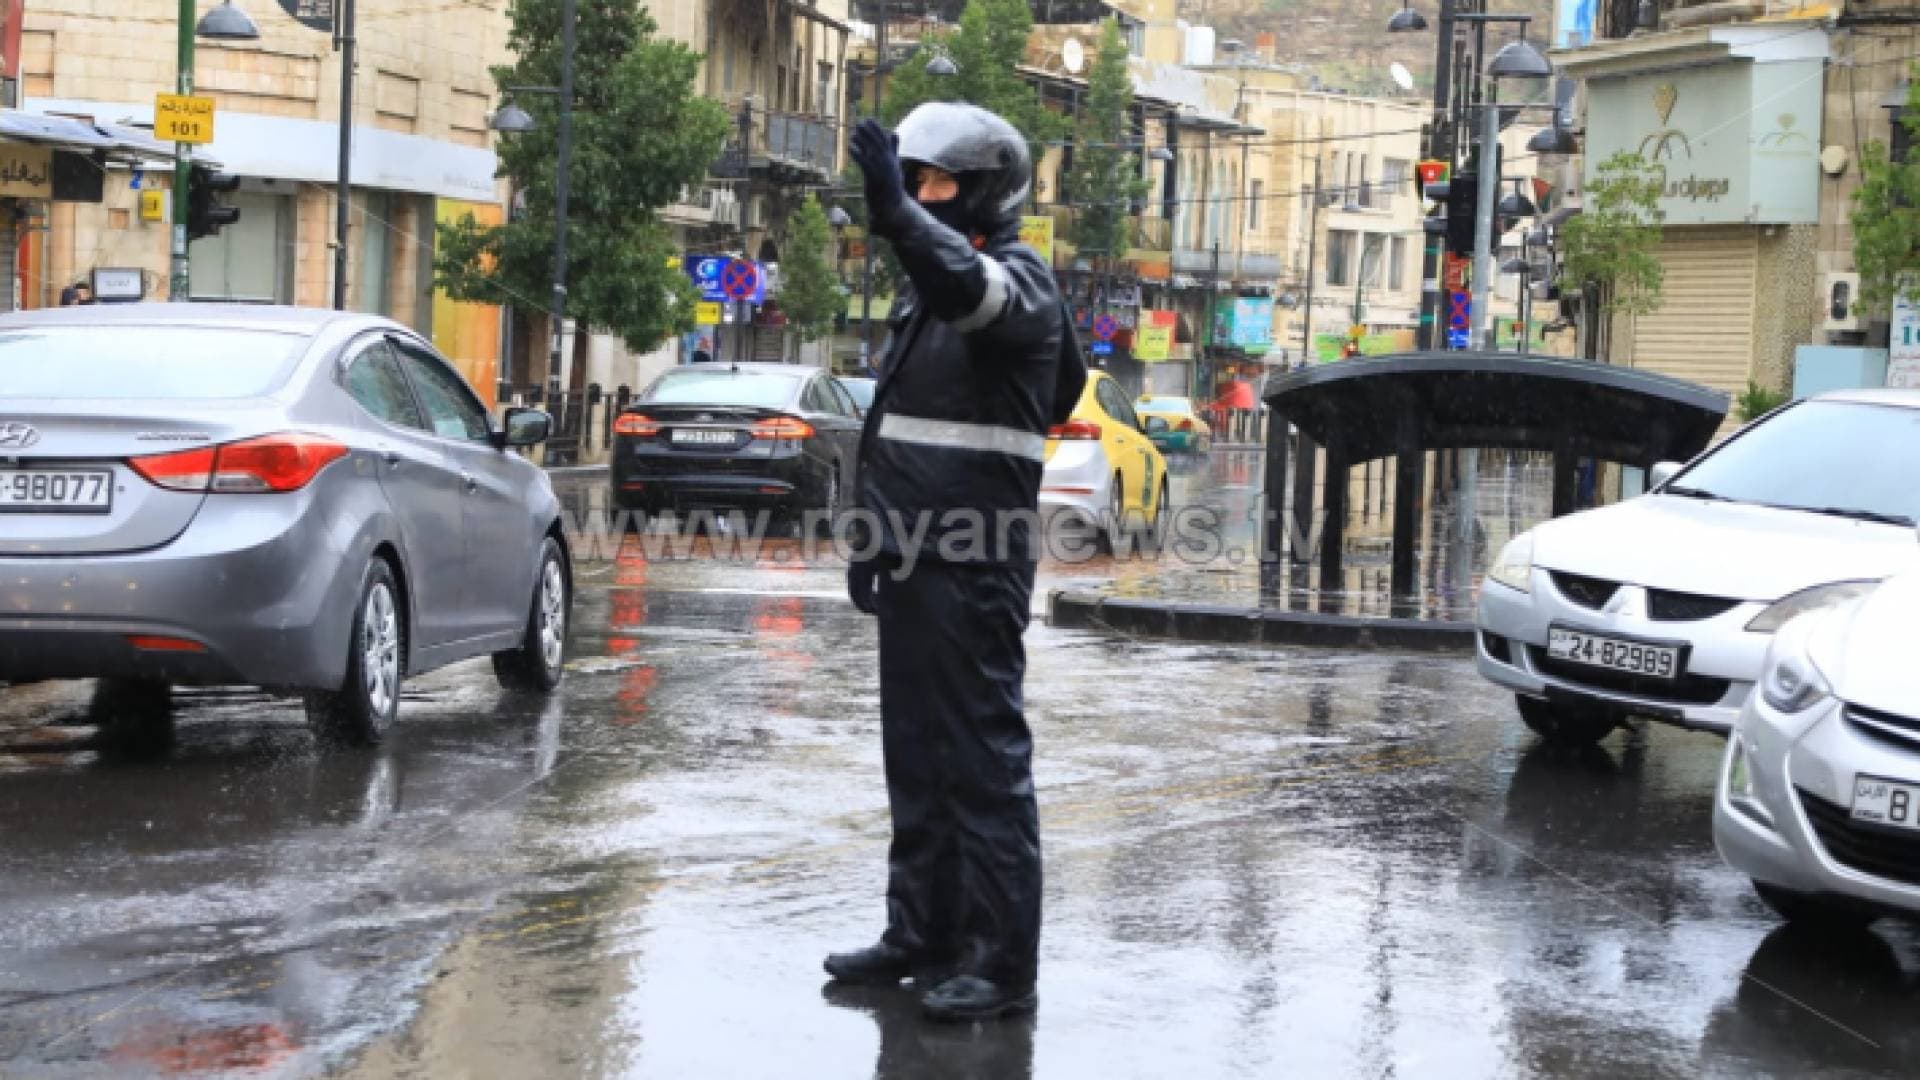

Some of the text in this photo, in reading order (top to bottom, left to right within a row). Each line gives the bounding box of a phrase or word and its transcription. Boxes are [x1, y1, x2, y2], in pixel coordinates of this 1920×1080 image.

[169, 120, 199, 136] 101
[0, 474, 104, 502] -98077
[1568, 635, 1674, 676] 24-82989
